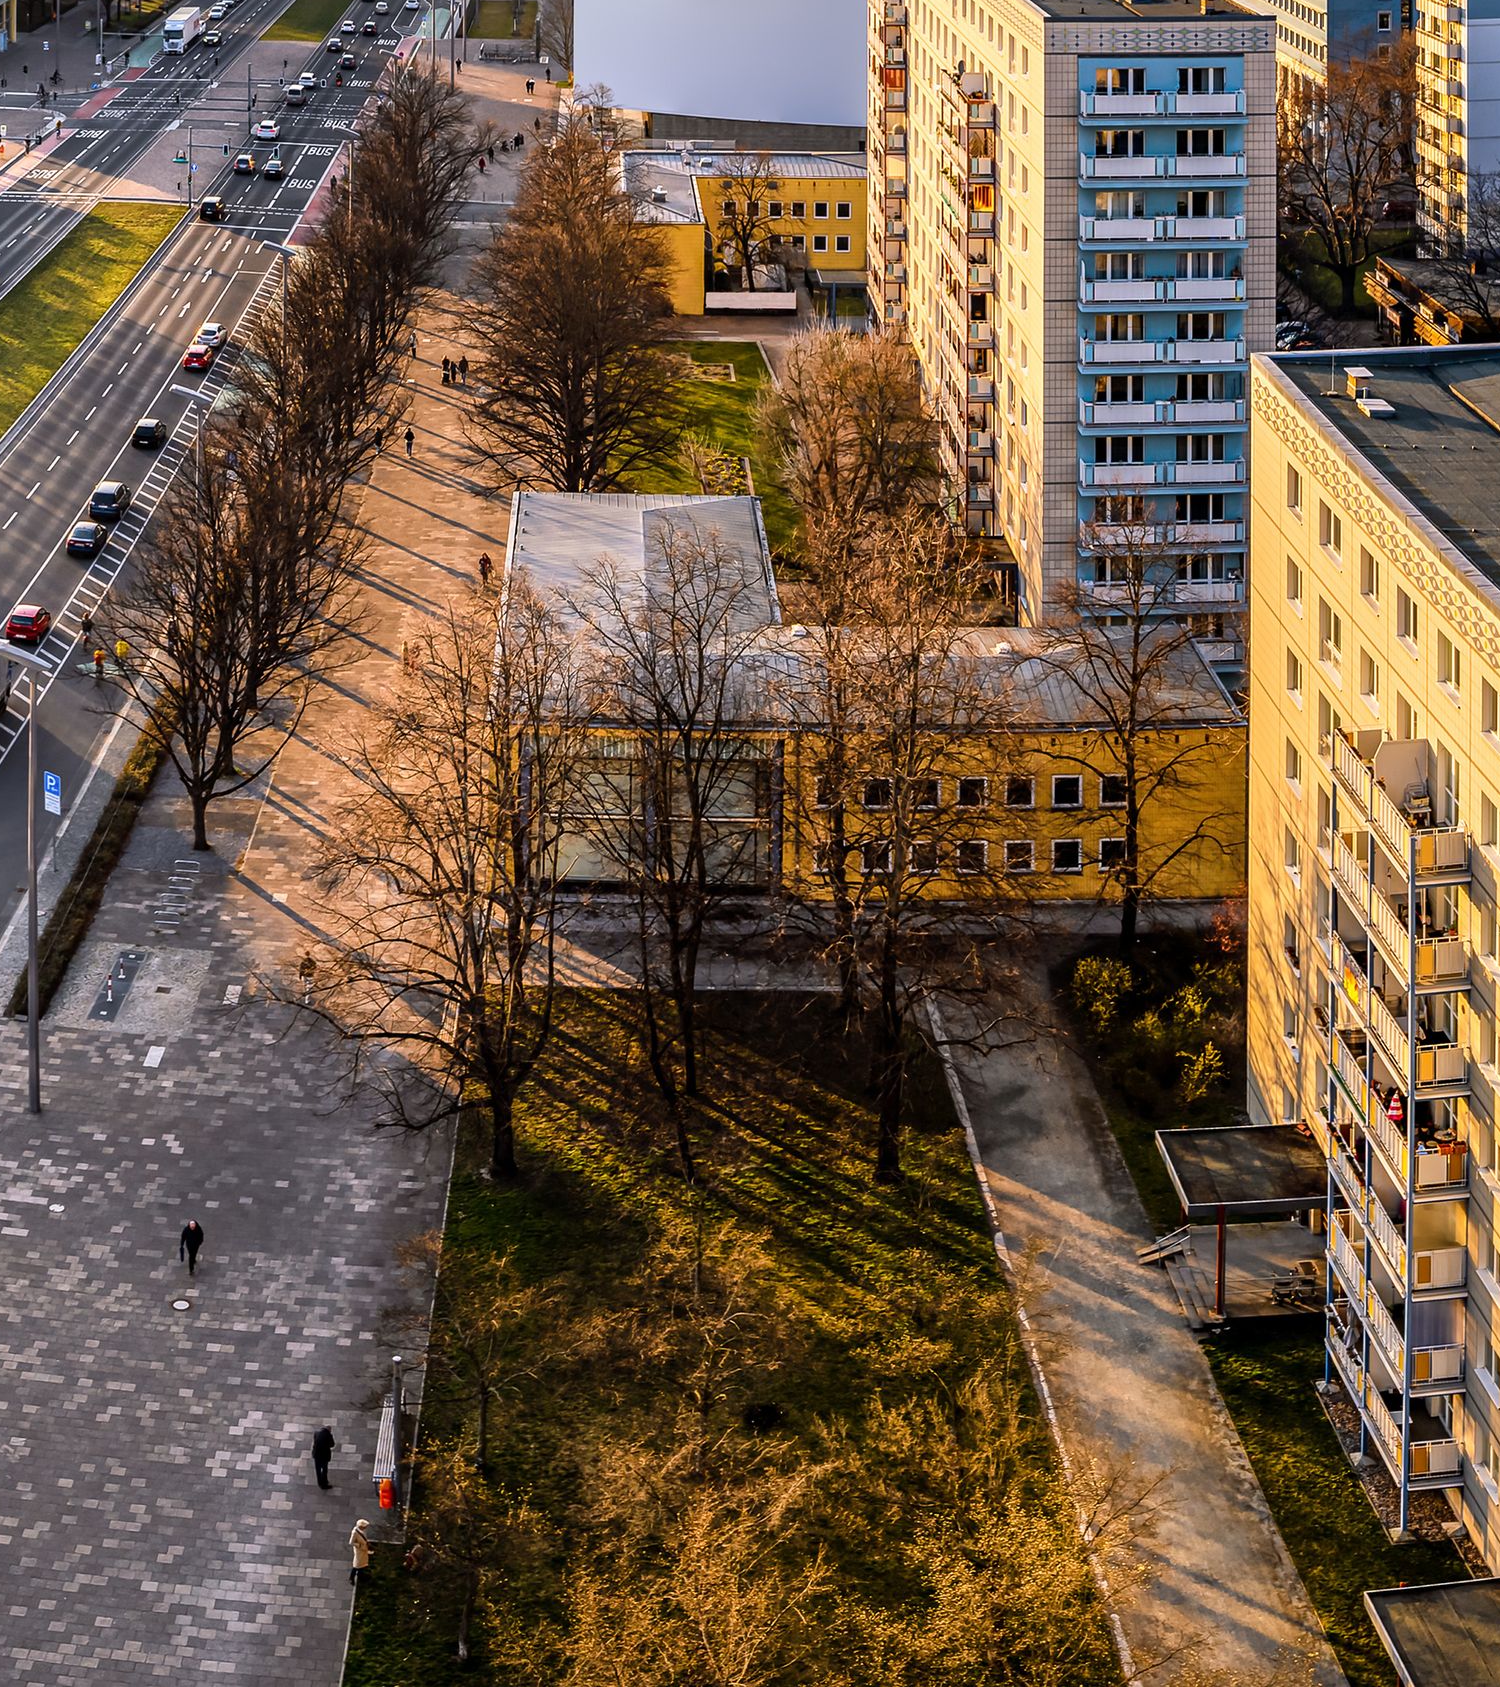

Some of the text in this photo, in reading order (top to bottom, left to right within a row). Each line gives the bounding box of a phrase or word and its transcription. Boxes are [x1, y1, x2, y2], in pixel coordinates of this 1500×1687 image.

[350, 79, 372, 88] BUS
[324, 119, 349, 128] BUS
[75, 129, 104, 139] BUS
[307, 146, 334, 157] BUS
[26, 169, 57, 179] BUS
[287, 178, 316, 190] BUS
[47, 775, 56, 790] P
